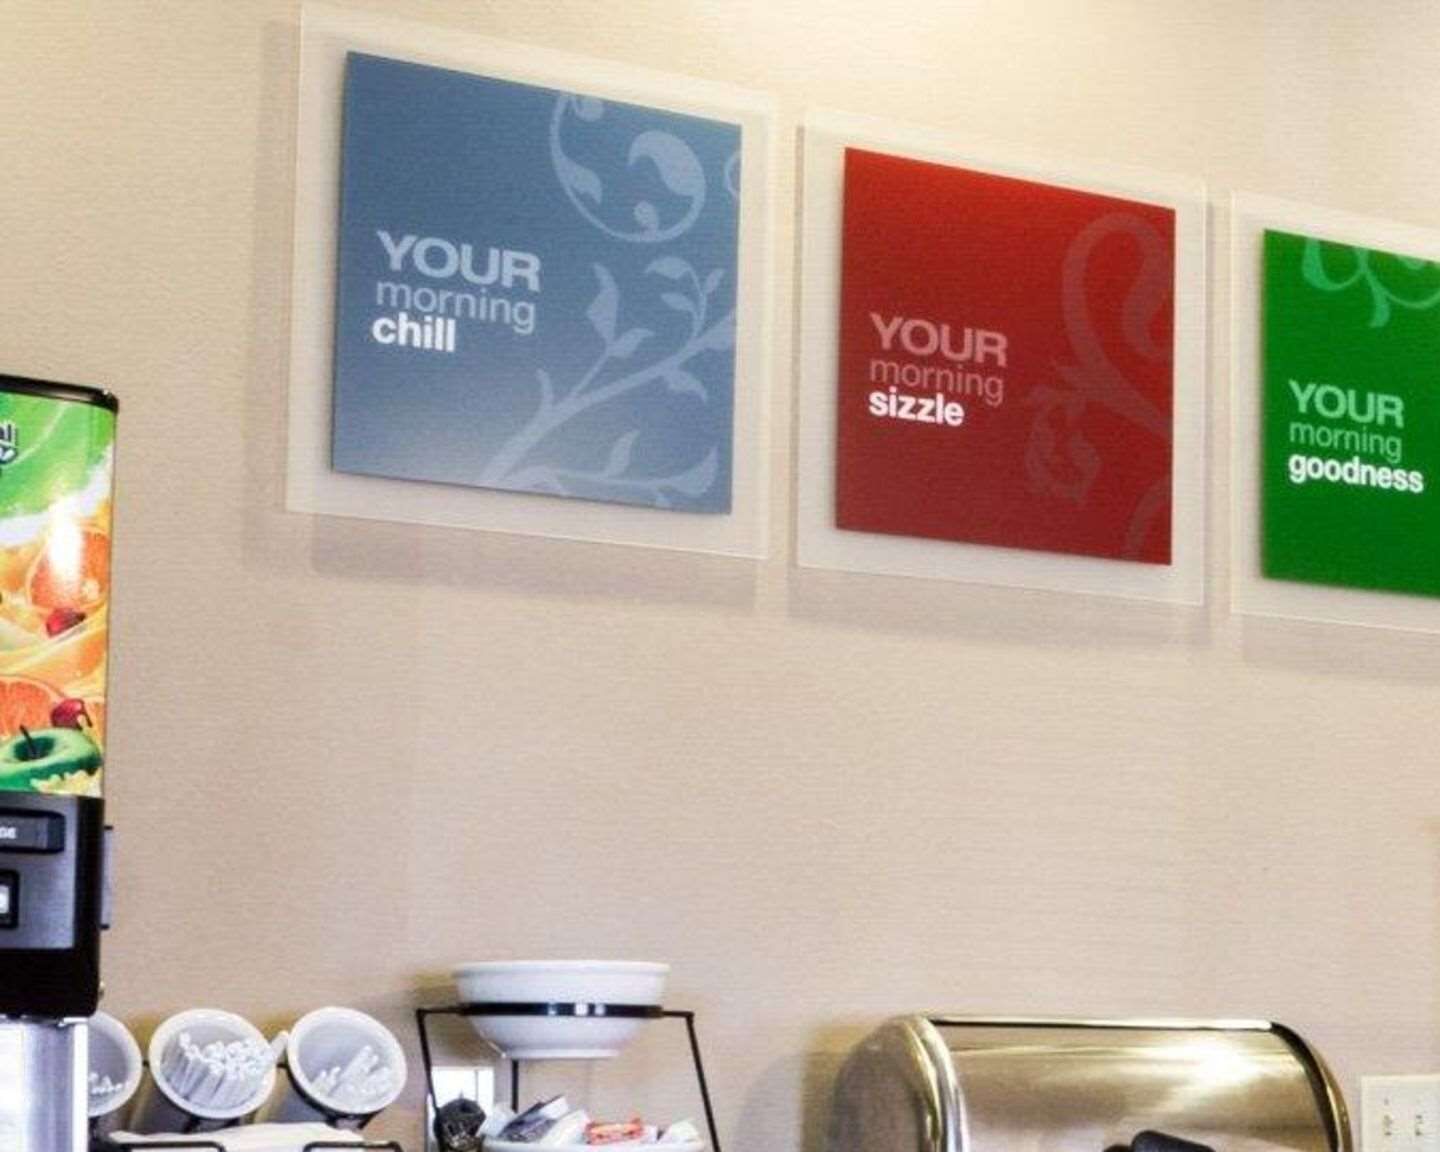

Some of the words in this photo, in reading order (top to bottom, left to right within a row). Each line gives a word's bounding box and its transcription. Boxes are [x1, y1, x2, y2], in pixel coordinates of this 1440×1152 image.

[376, 230, 541, 292] YOUR
[373, 312, 456, 352] chill
[375, 281, 535, 335] morning
[870, 312, 1008, 367] YOUR
[869, 386, 965, 427] sizzle
[870, 359, 1003, 407] morning
[1288, 379, 1404, 428] YOUR
[1289, 422, 1402, 464] morning
[1288, 453, 1424, 493] goodness
